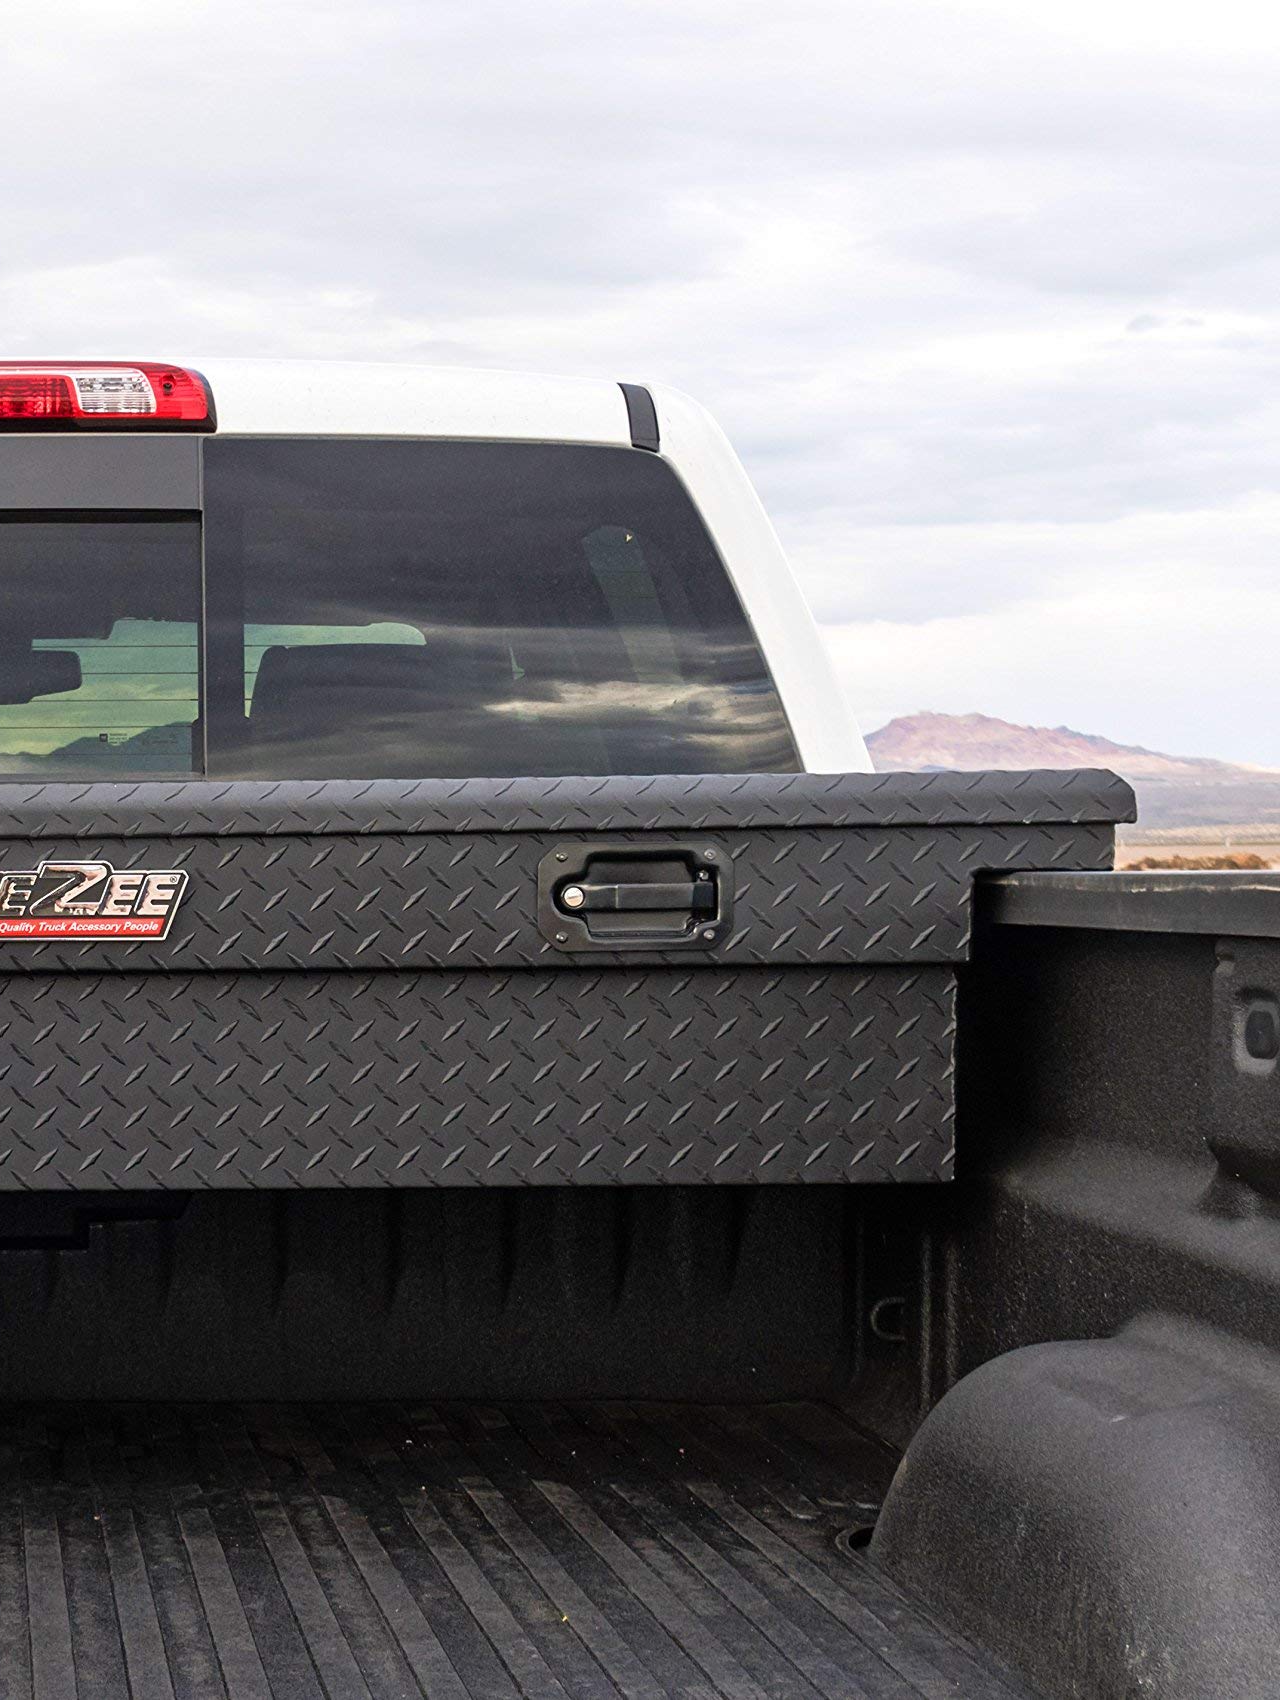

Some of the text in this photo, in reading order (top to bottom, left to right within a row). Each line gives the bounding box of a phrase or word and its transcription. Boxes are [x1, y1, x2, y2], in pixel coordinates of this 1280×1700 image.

[38, 921, 67, 932] Truck
[68, 921, 122, 933] Accessory
[123, 921, 159, 932] People
